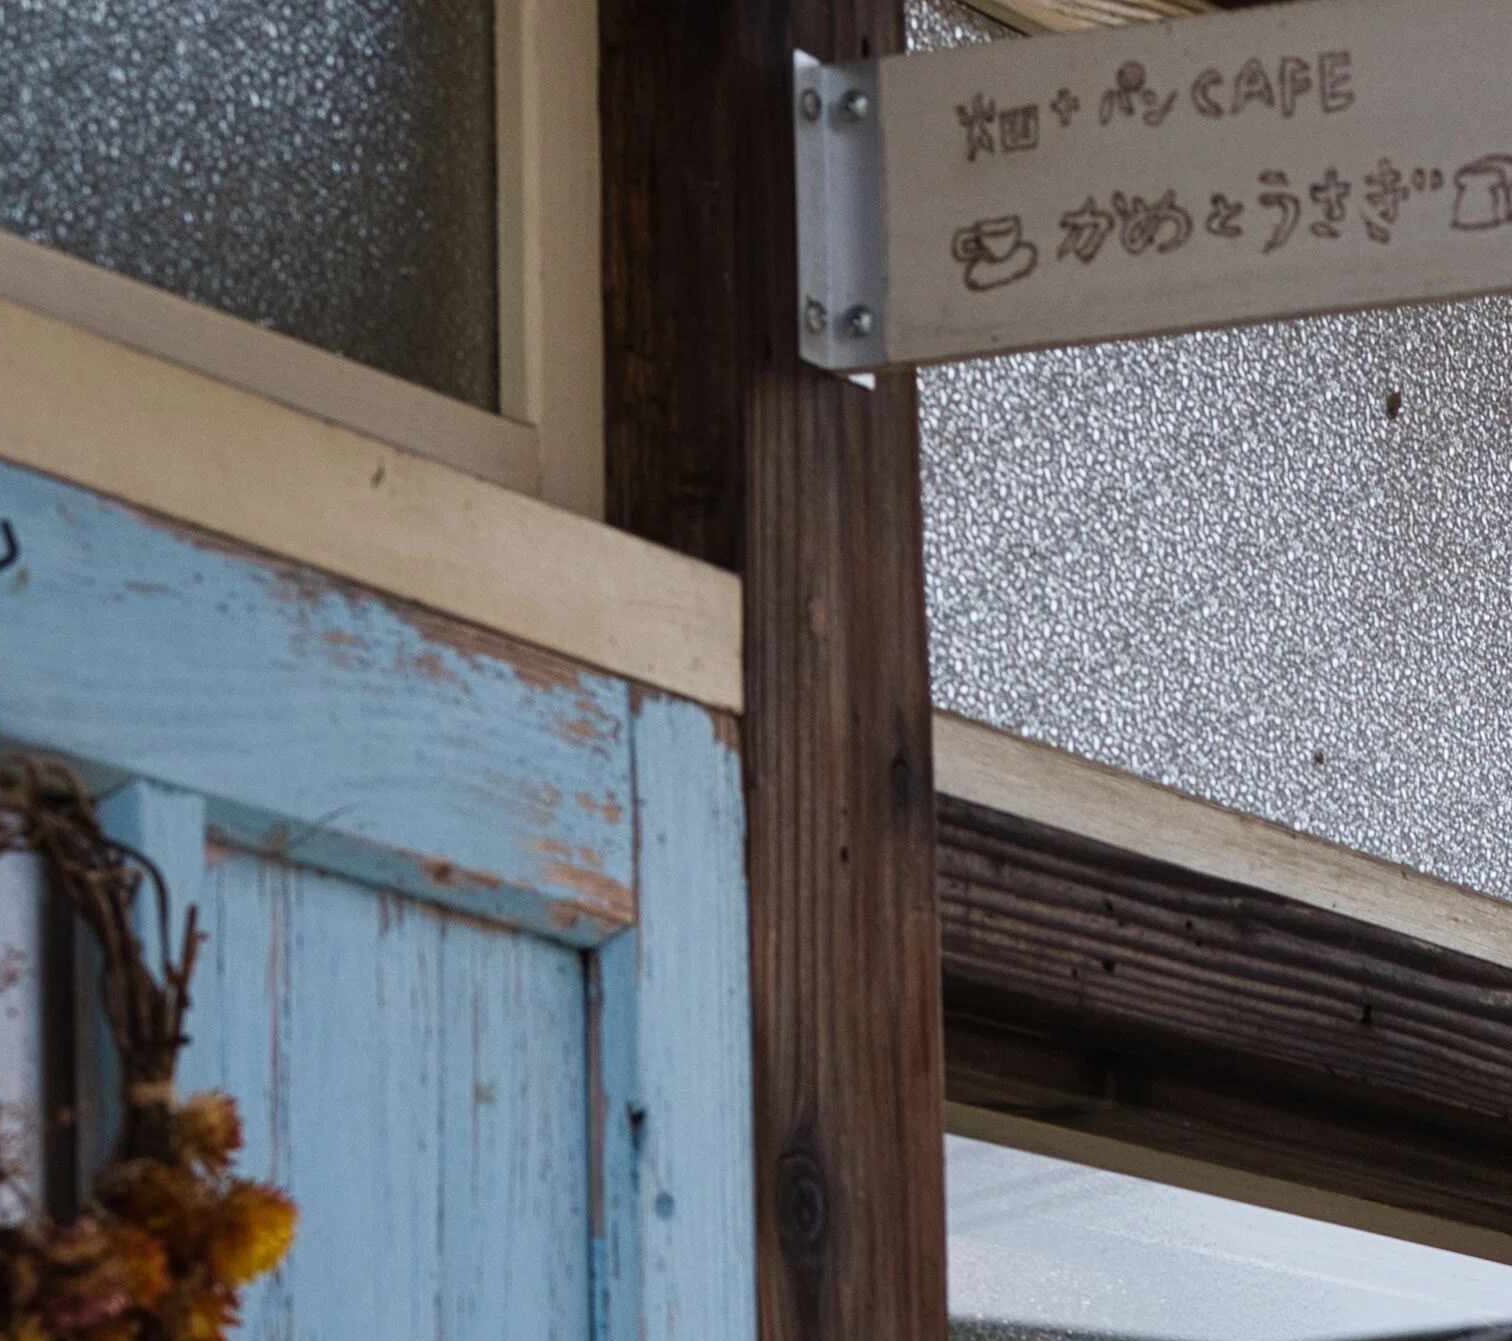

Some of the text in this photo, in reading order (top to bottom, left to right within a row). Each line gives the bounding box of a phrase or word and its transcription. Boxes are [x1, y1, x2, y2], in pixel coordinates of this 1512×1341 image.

[1055, 157, 1444, 264] かめとうさぎ
